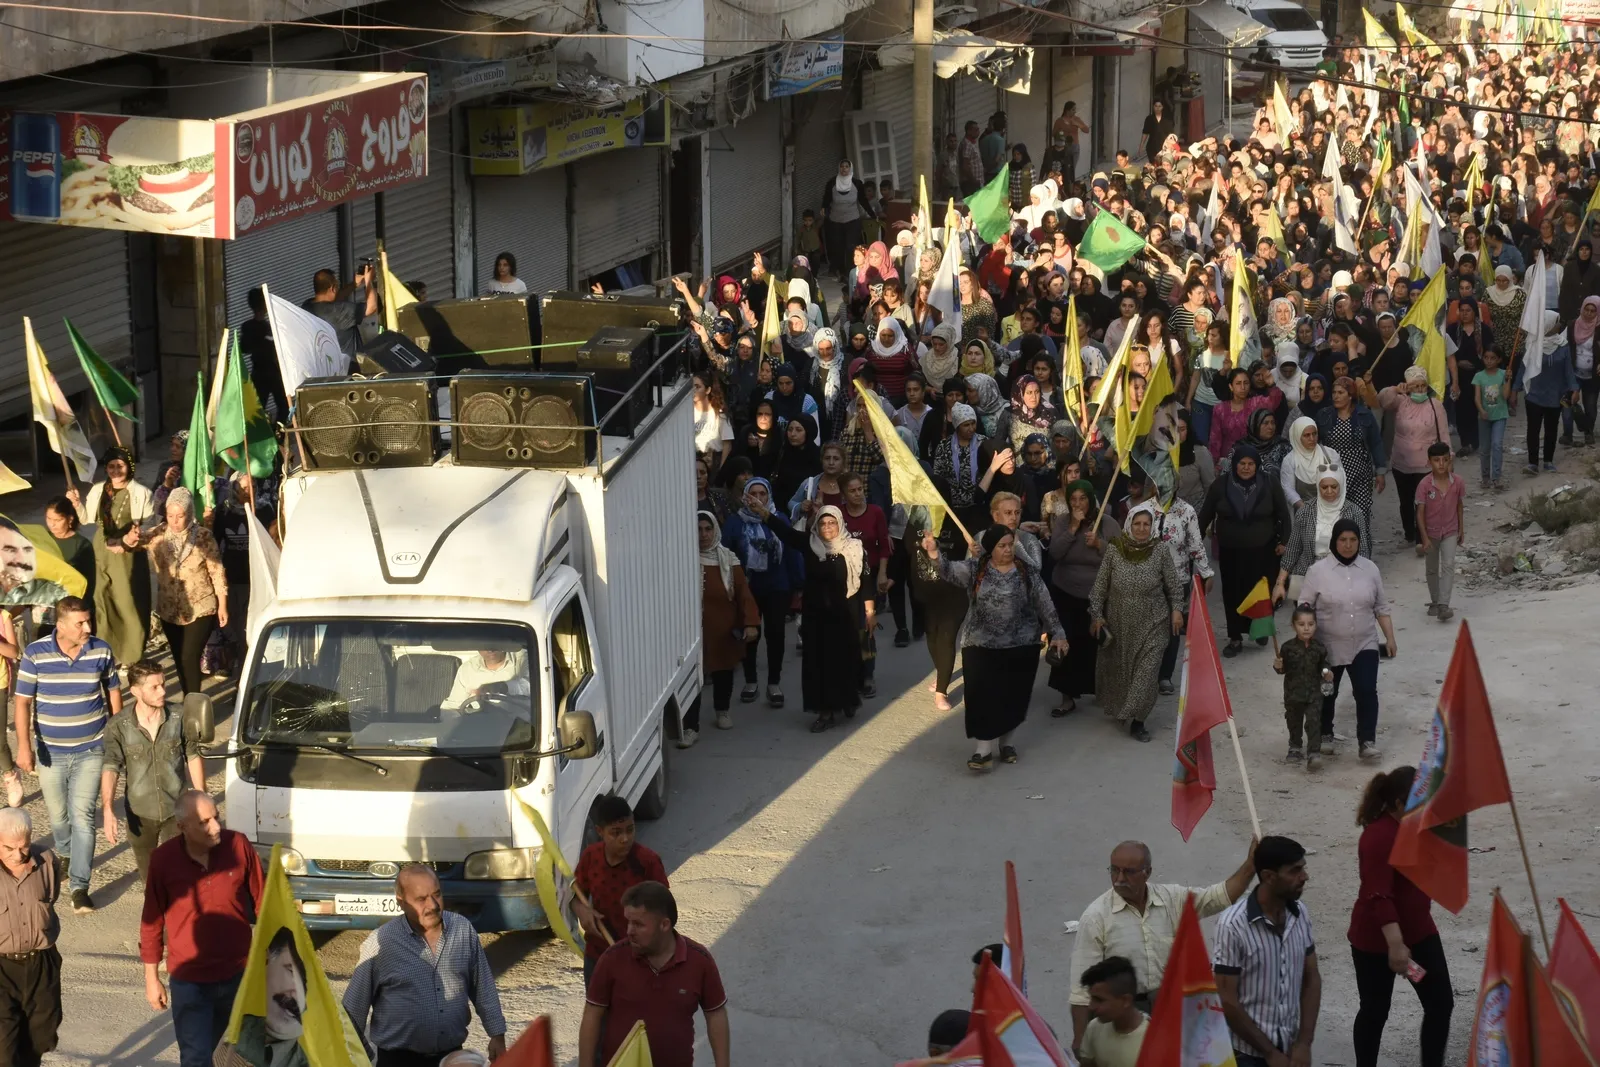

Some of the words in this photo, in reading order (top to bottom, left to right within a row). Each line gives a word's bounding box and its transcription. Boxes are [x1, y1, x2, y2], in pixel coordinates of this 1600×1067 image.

[323, 101, 352, 123] KORAN
[362, 91, 411, 173] فروج
[12, 150, 56, 164] PEPSI
[250, 112, 312, 201] كوران
[374, 865, 394, 875] KIA
